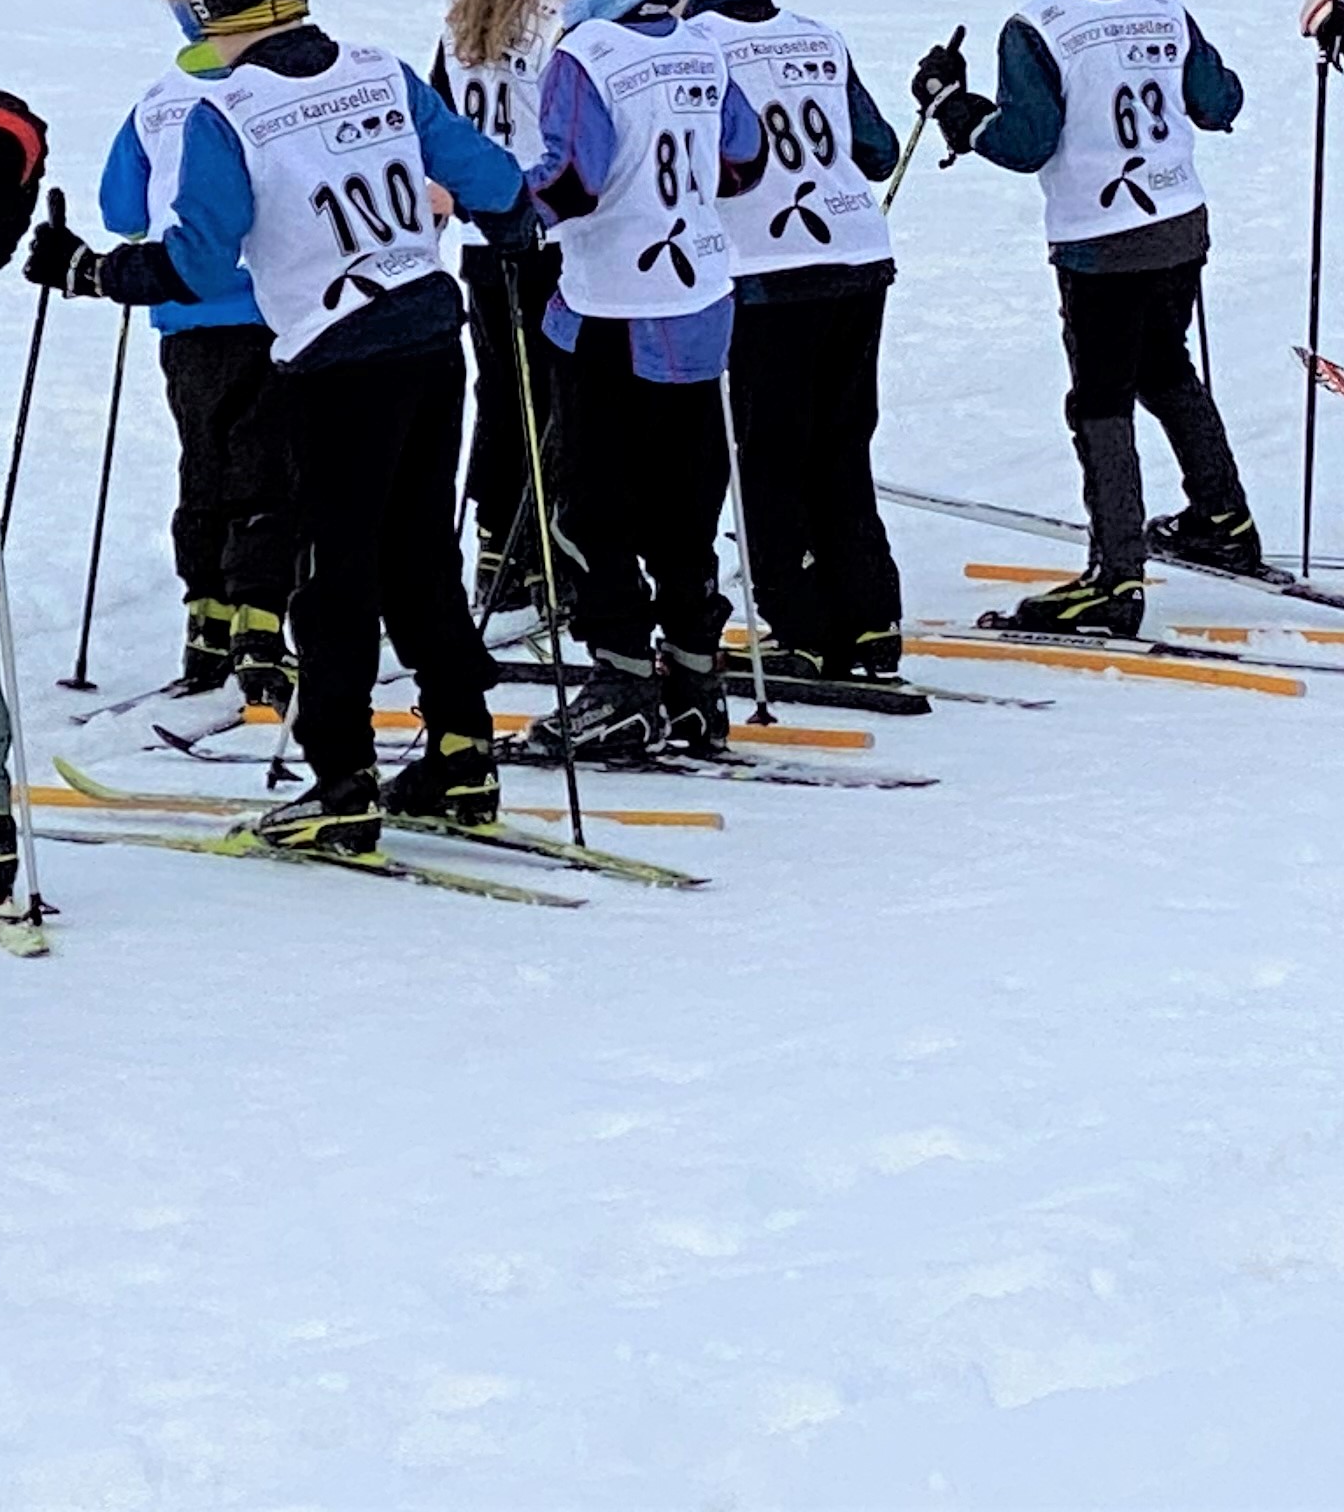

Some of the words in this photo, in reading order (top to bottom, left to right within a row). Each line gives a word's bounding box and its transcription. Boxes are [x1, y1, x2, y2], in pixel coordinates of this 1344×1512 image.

[760, 97, 836, 173] 89
[1112, 79, 1170, 150] 63
[309, 155, 423, 257] 100
